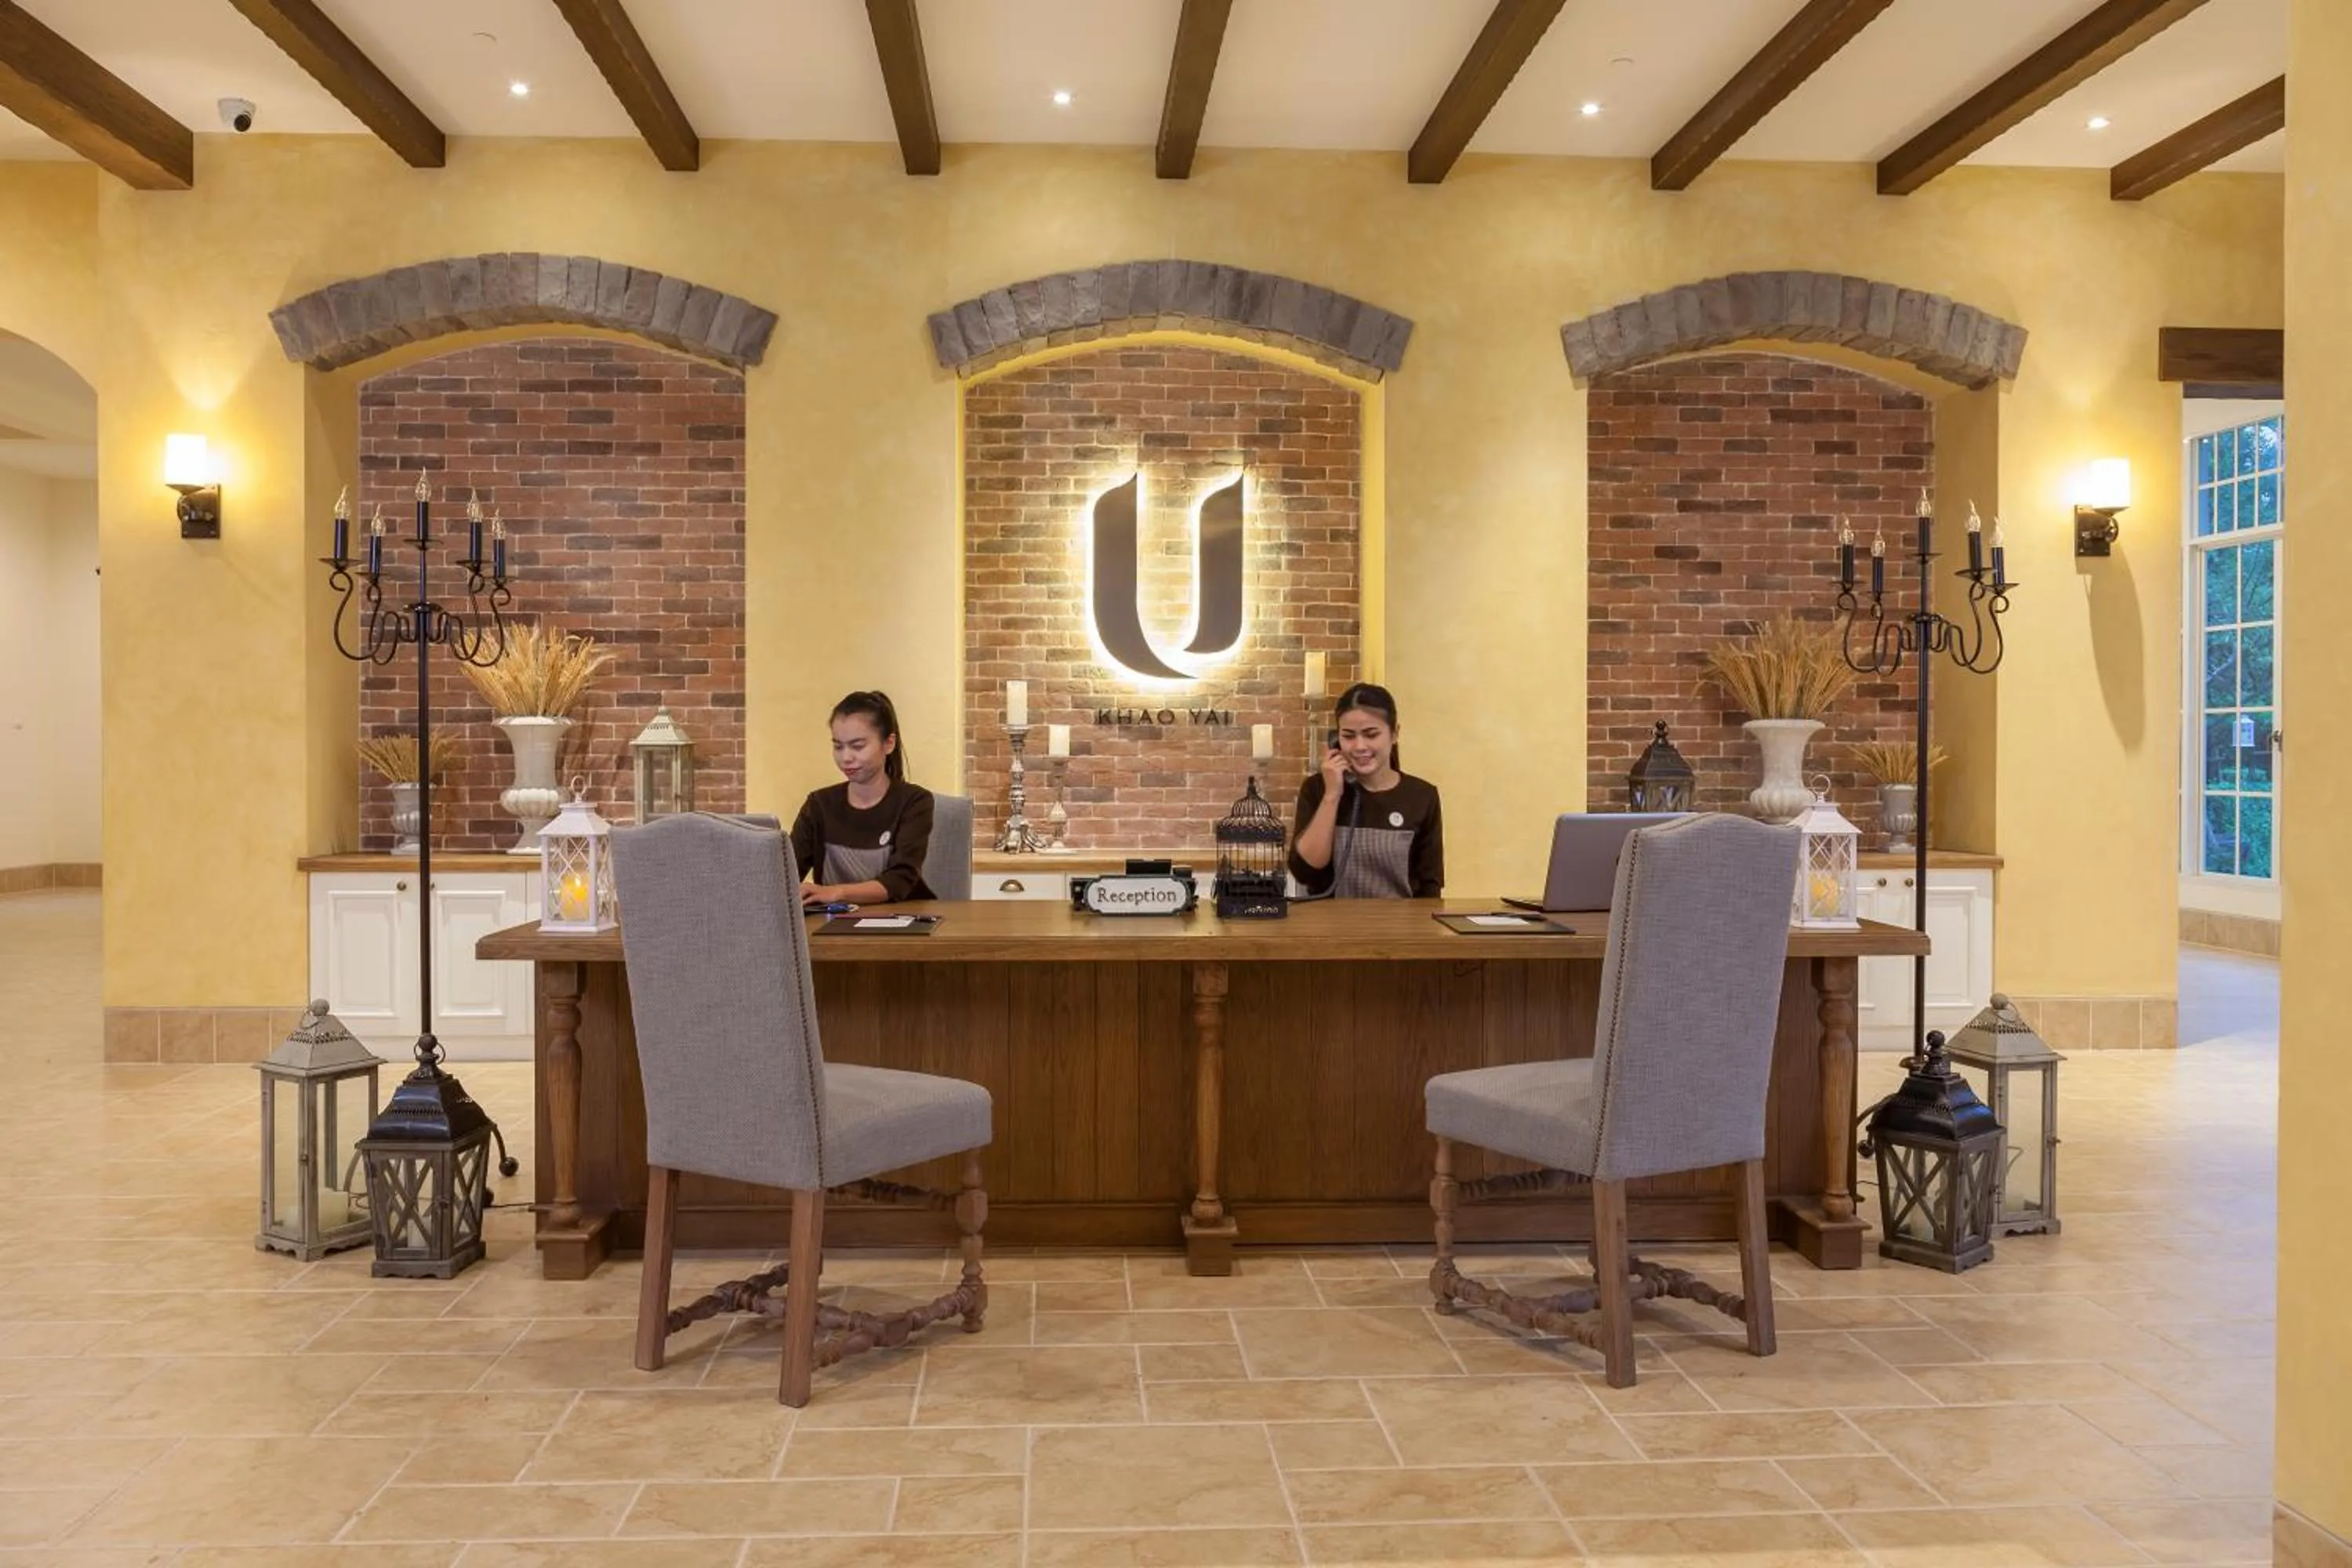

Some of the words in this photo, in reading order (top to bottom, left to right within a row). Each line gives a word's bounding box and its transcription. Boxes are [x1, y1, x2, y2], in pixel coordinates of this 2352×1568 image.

[1098, 709, 1175, 725] KHAO
[1189, 709, 1229, 725] YAI
[1097, 887, 1177, 906] Reception
